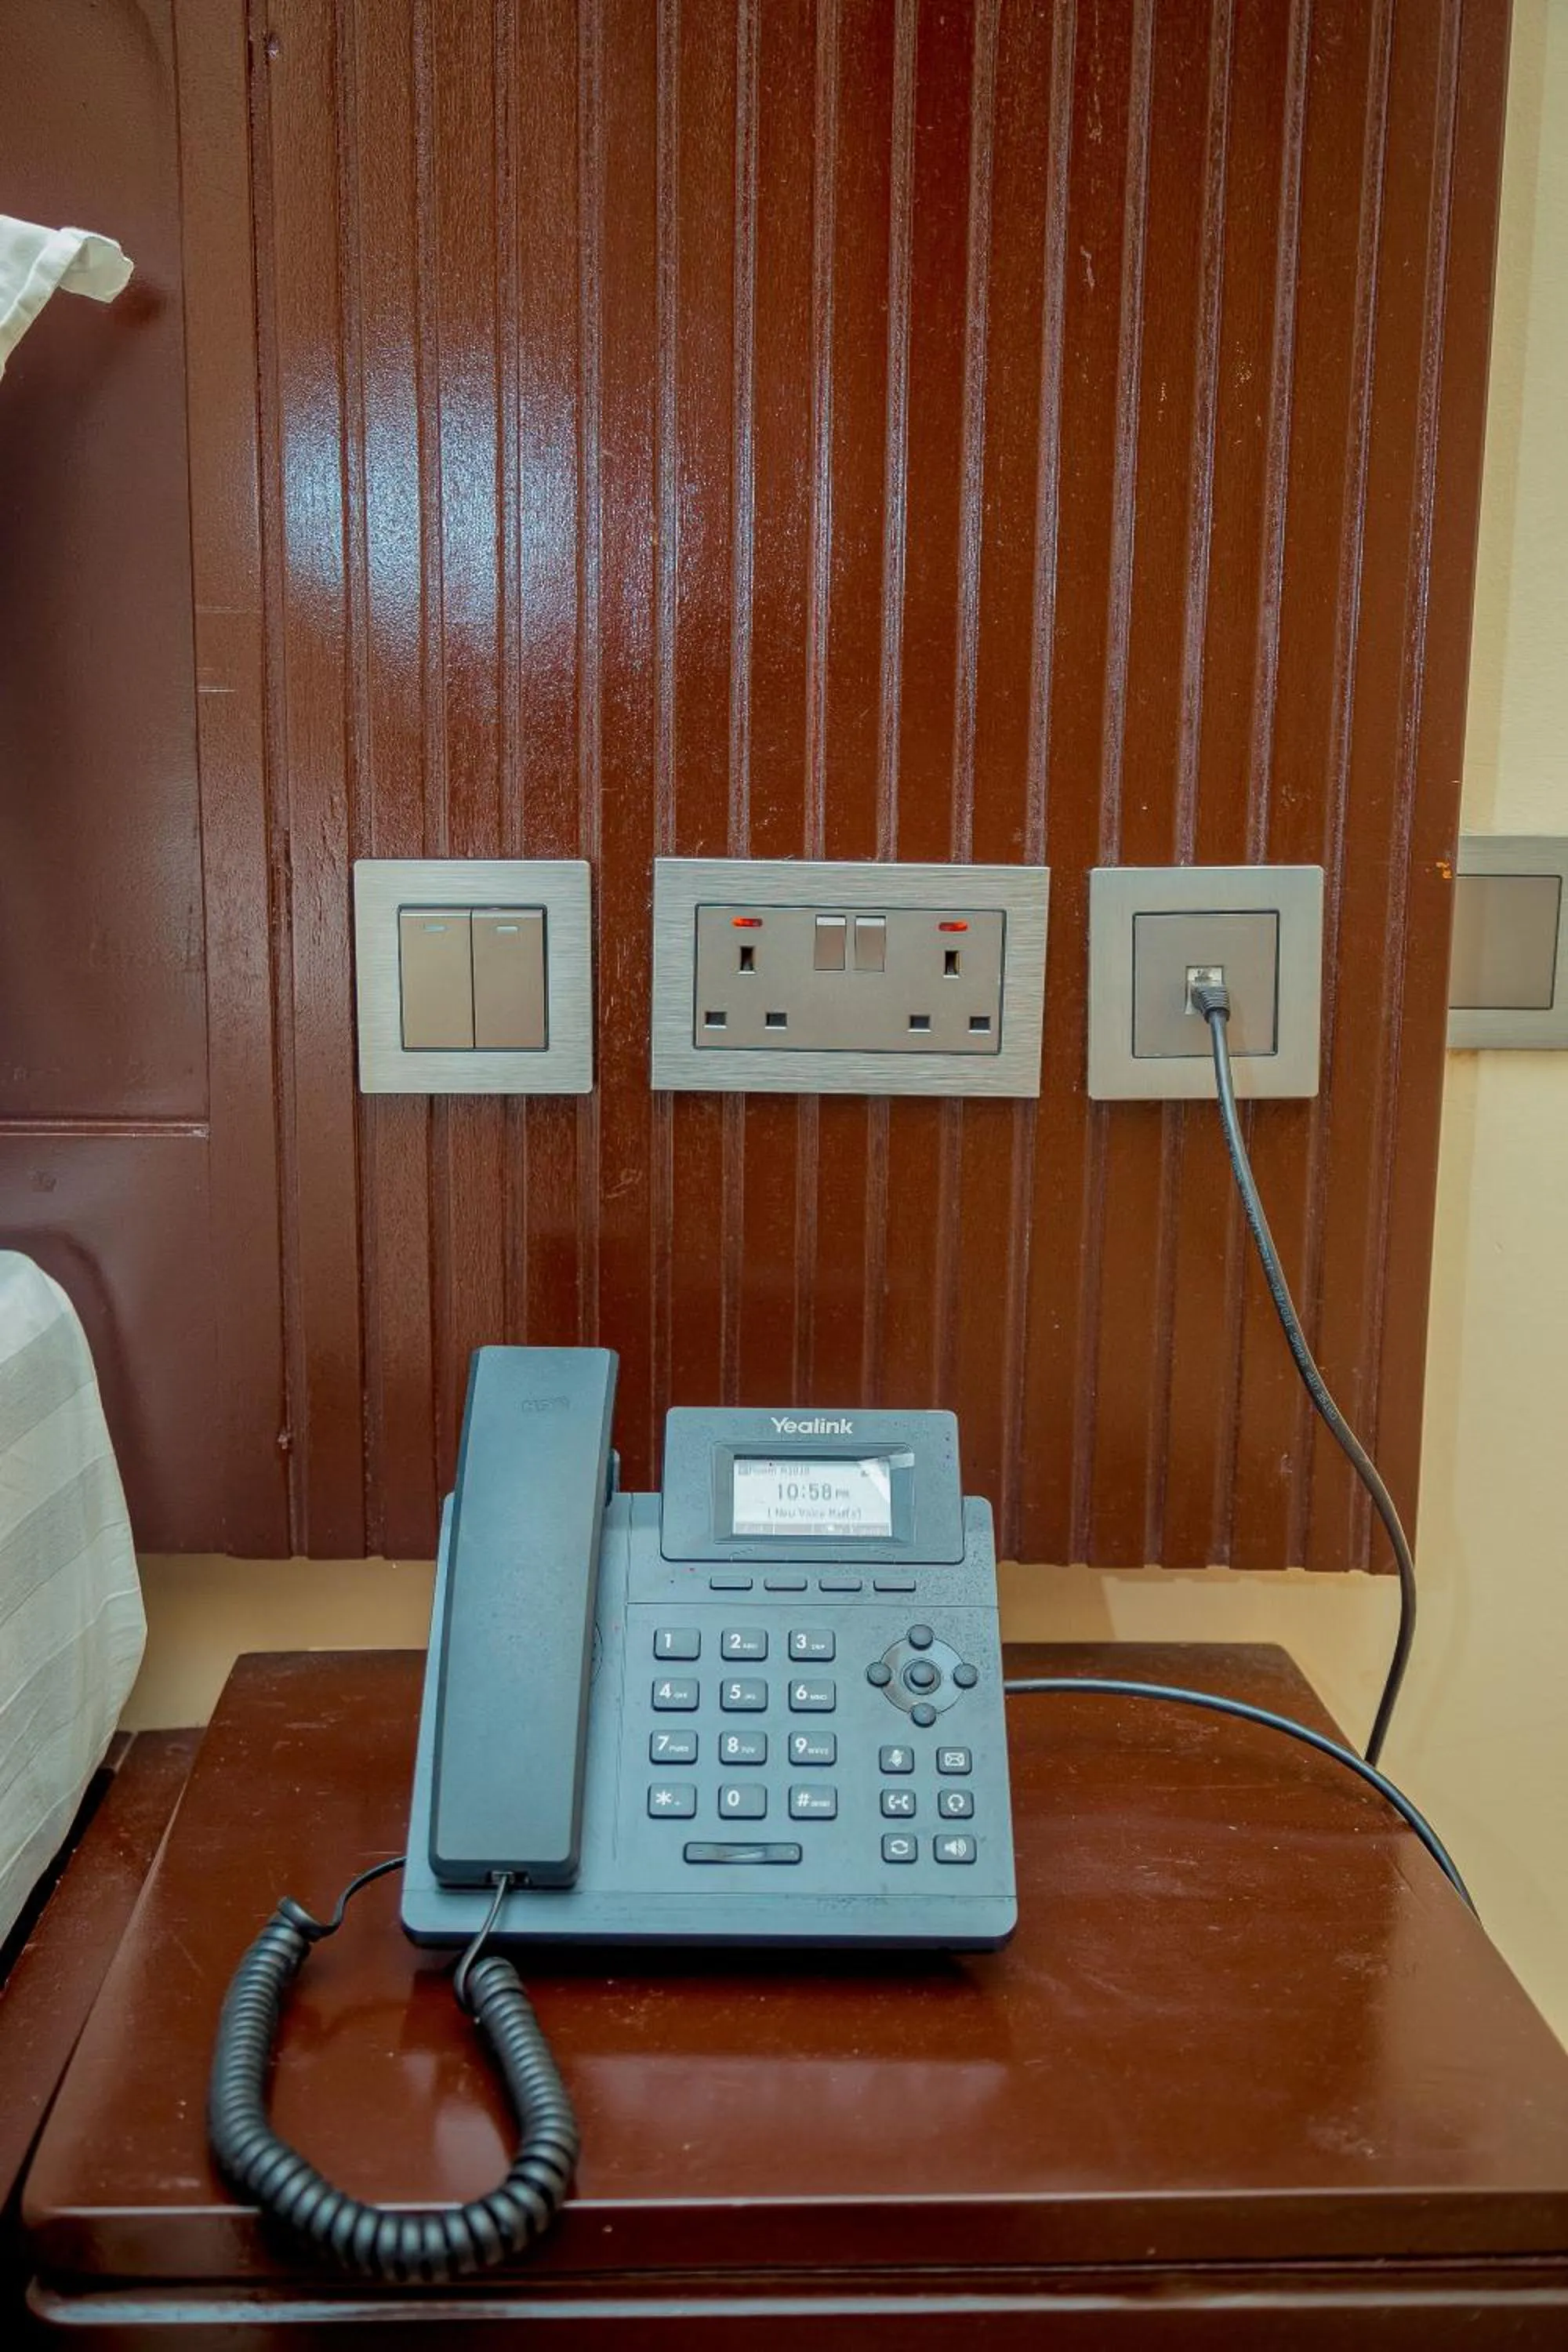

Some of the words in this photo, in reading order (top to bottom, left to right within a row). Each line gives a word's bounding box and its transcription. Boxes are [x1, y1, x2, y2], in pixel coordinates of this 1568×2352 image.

[771, 1417, 854, 1434] Yealink
[778, 1483, 832, 1501] 10:58
[664, 1633, 672, 1649] 1
[730, 1633, 741, 1649] 2
[796, 1633, 808, 1650] 3
[659, 1683, 672, 1700] 4
[729, 1684, 741, 1700] 5
[796, 1684, 808, 1700] 6
[657, 1735, 670, 1751] 7
[727, 1736, 739, 1753] 8
[795, 1737, 808, 1754] 9
[727, 1790, 740, 1807] 0
[797, 1792, 810, 1808] #
